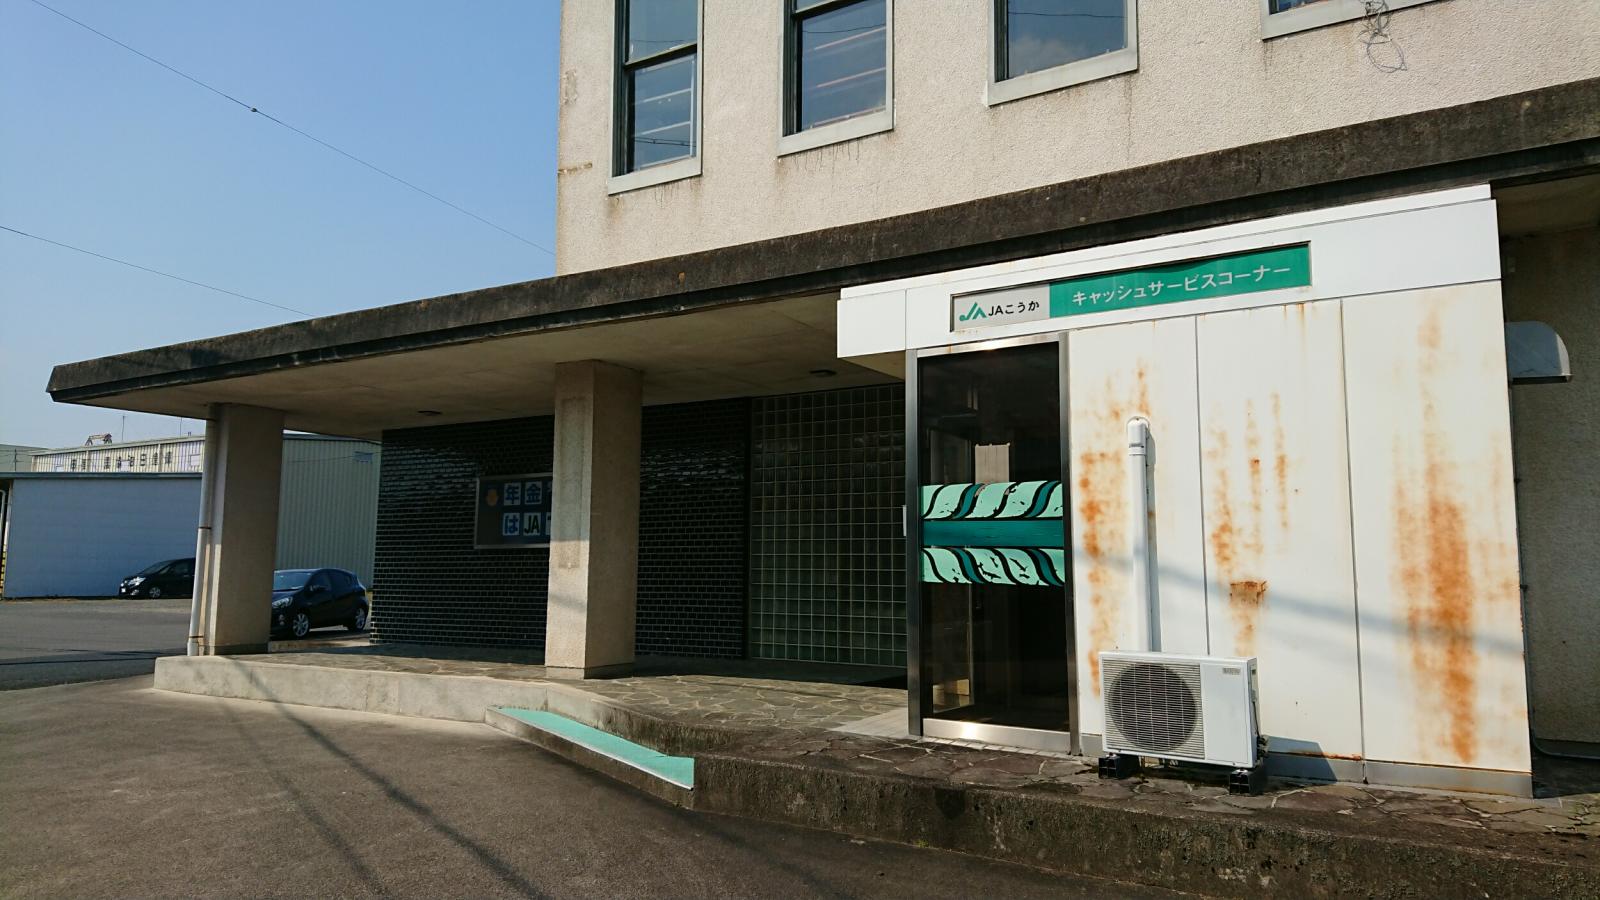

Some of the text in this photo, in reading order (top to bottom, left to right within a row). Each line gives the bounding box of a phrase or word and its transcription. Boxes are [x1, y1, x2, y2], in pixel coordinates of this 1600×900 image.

[1072, 264, 1291, 306] キャッシュサービスコーナー
[988, 300, 1040, 316] JAこうか
[505, 482, 552, 504] 年金
[505, 515, 551, 534] はJA
